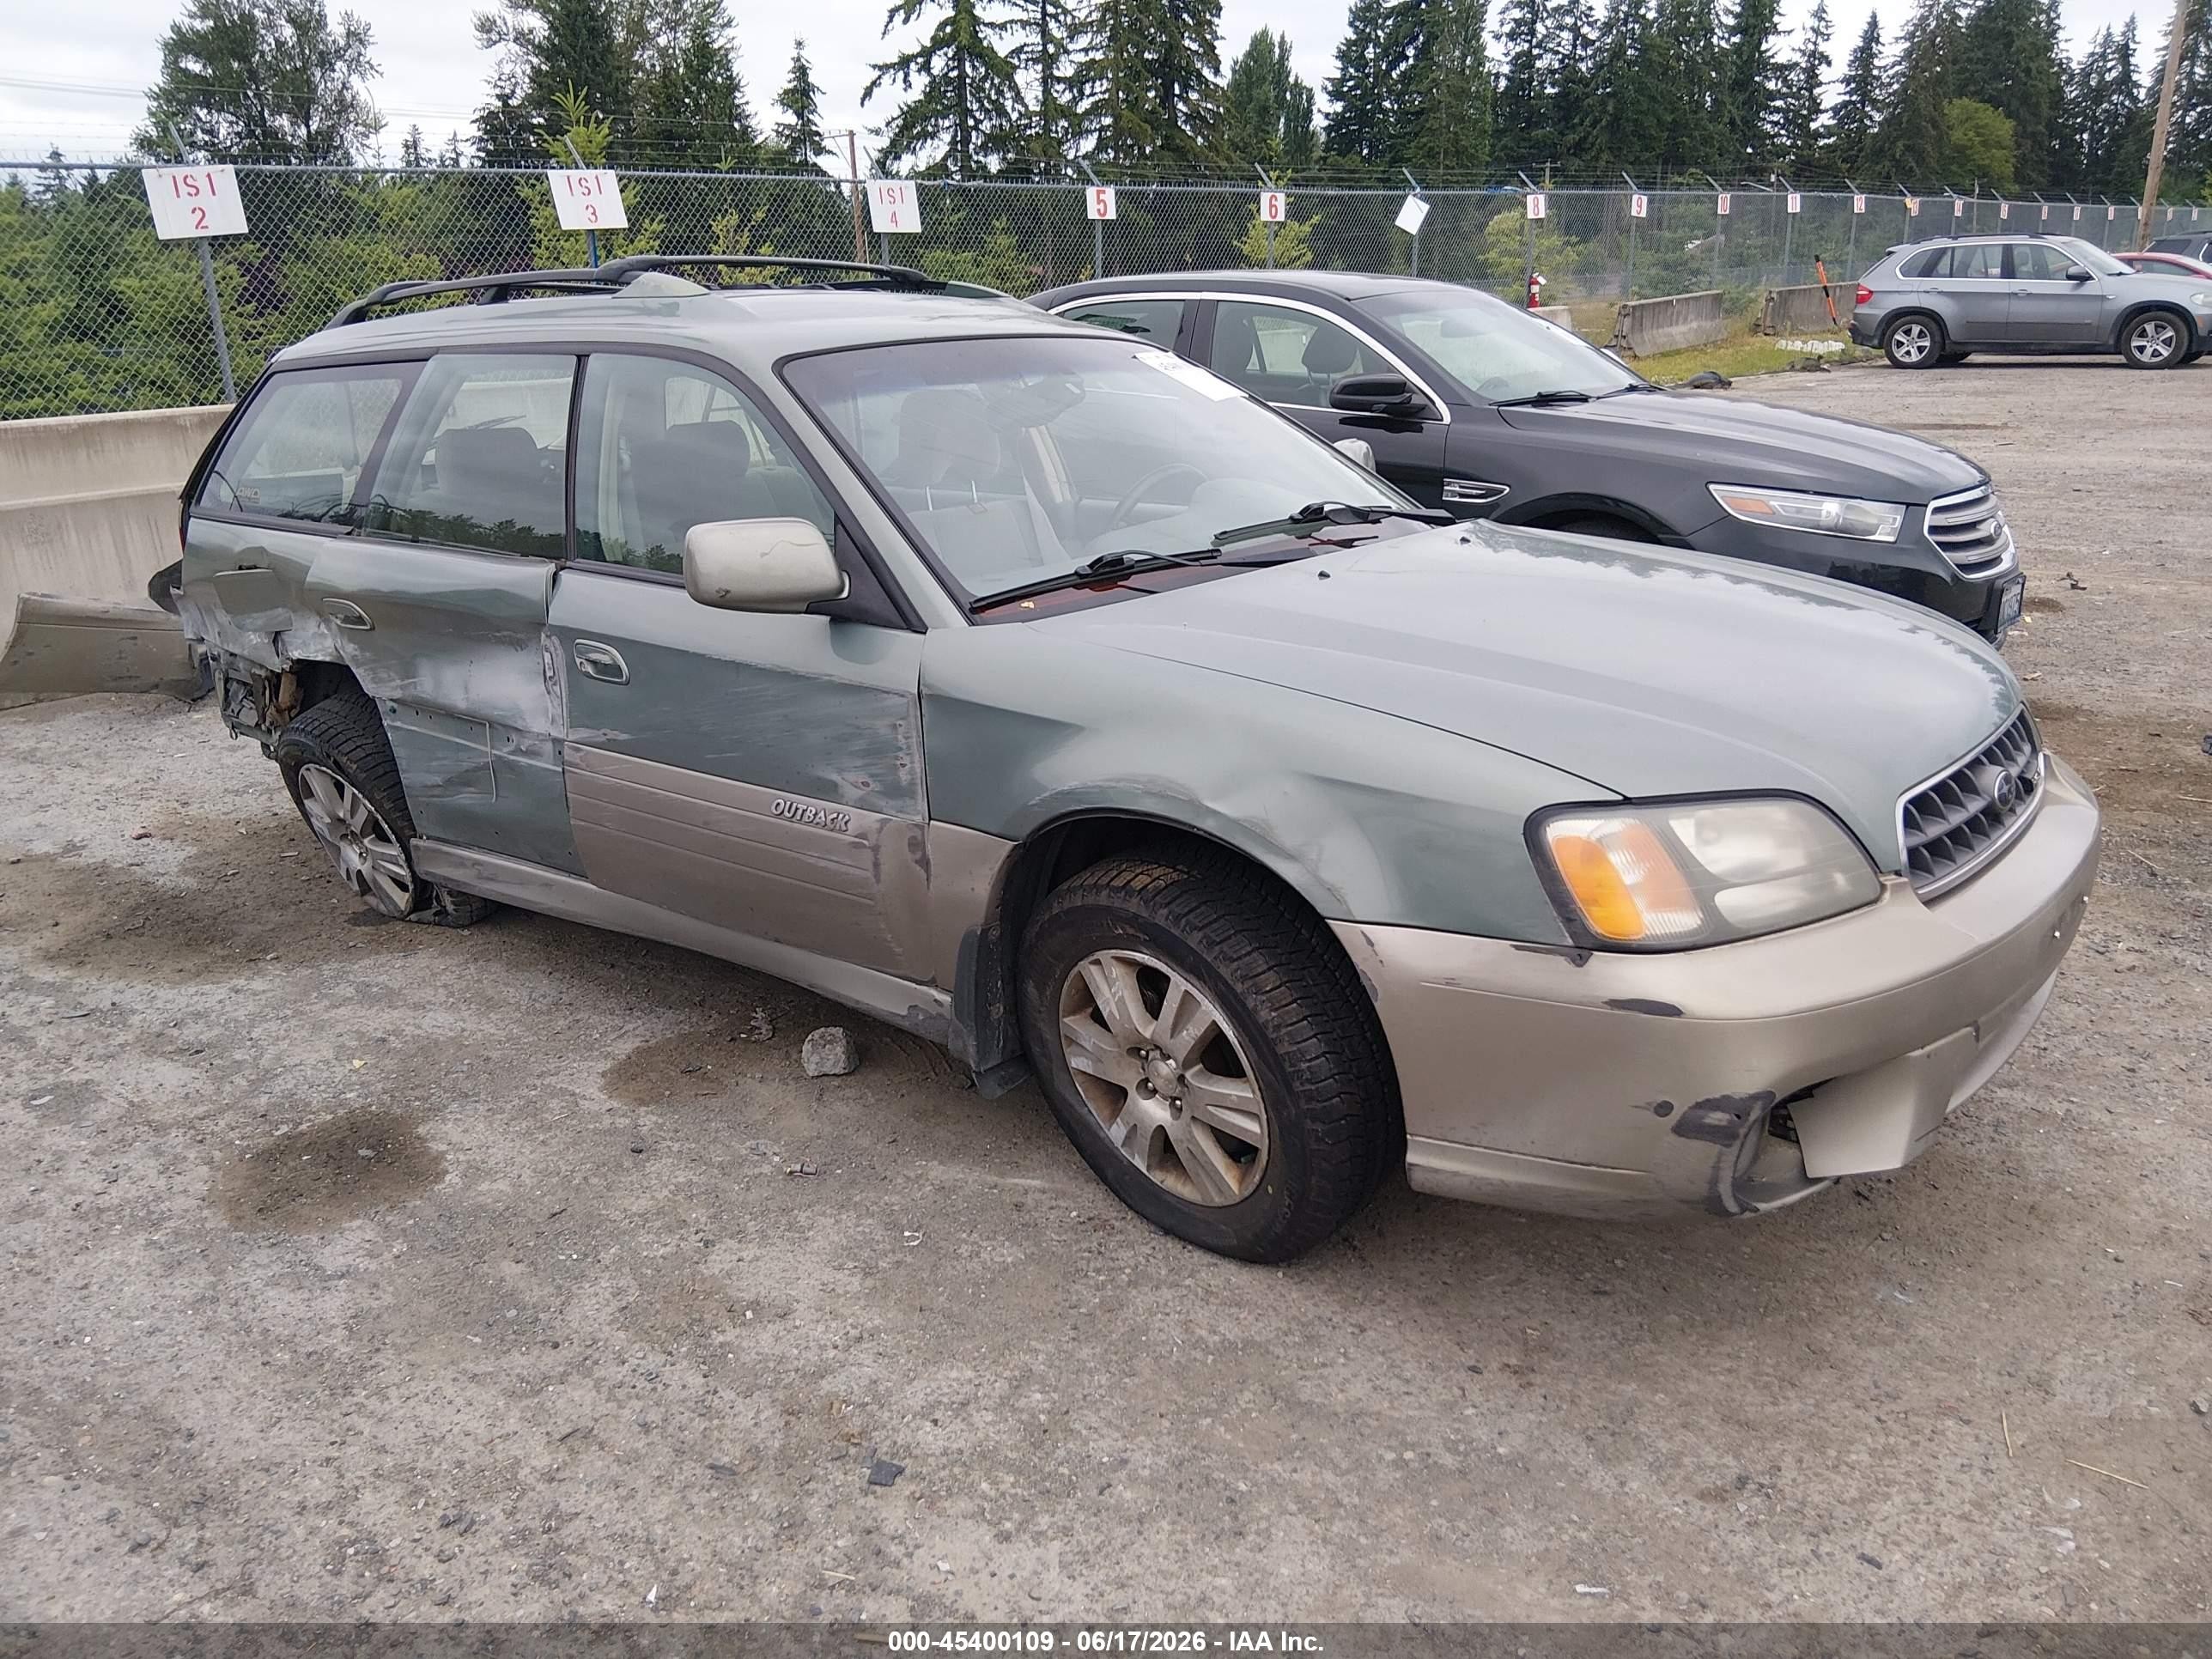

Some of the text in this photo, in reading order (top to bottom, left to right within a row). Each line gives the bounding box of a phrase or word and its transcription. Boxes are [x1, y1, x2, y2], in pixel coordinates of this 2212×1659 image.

[586, 204, 599, 223] 3
[1096, 189, 1108, 218] 5
[1268, 194, 1279, 220] 6
[1532, 196, 1540, 216] 8
[1636, 196, 1643, 216] 9
[1720, 196, 1729, 213] 10
[1790, 196, 1797, 211] 11
[1856, 197, 1863, 211] 12
[191, 206, 209, 229] 2
[890, 210, 898, 228] 4
[771, 799, 851, 832] OUTBACK
